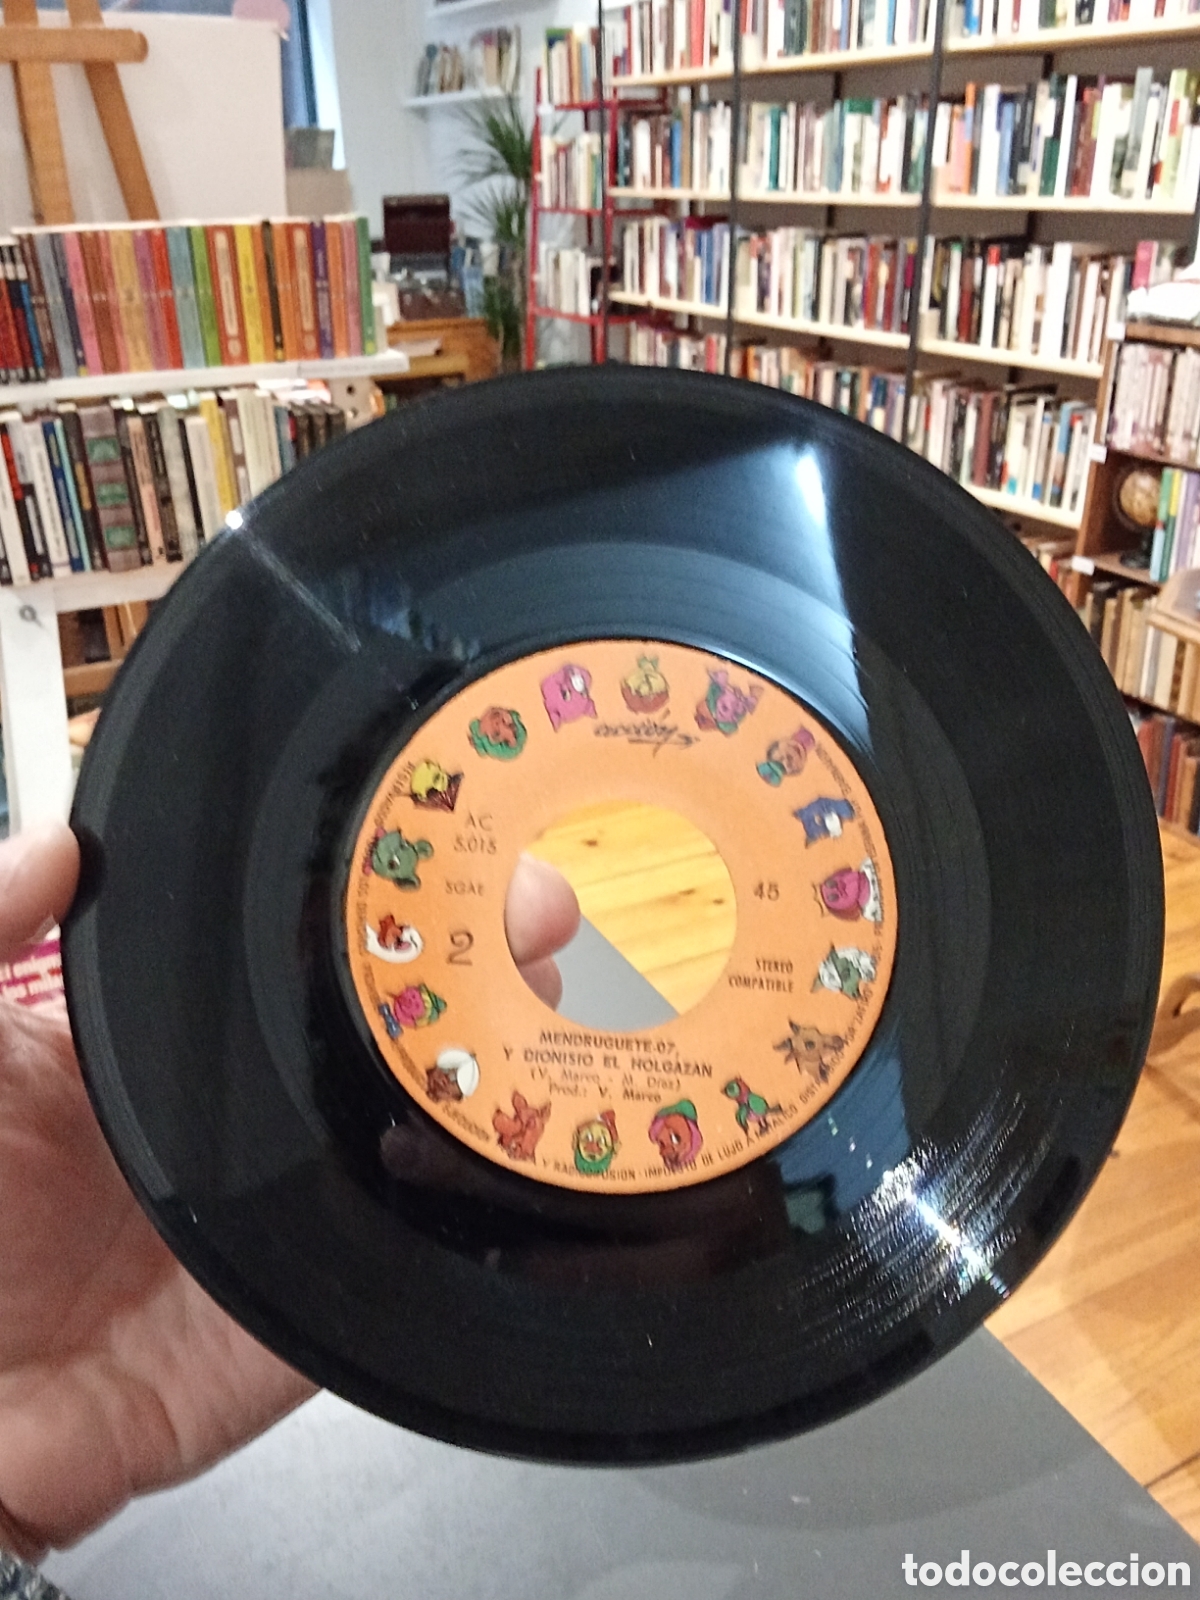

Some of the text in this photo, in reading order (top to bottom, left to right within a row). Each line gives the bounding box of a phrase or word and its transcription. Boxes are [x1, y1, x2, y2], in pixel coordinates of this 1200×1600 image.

[465, 811, 493, 831] AC
[753, 882, 780, 901] 45
[446, 929, 474, 966] 2
[755, 957, 793, 974] STEREO
[728, 974, 793, 993] COMPATIBLE
[503, 1045, 713, 1078] Y DIONISIO EL HOLGAZAN
[561, 1068, 600, 1084] Marco
[622, 1088, 662, 1103] Marco
[552, 1159, 635, 1180] RADUSION
[644, 1158, 698, 1179] IMPUTO
[716, 1138, 744, 1161] LUJO
[753, 1102, 799, 1141] MTALICO
[797, 1048, 845, 1104] DISTRUIDO
